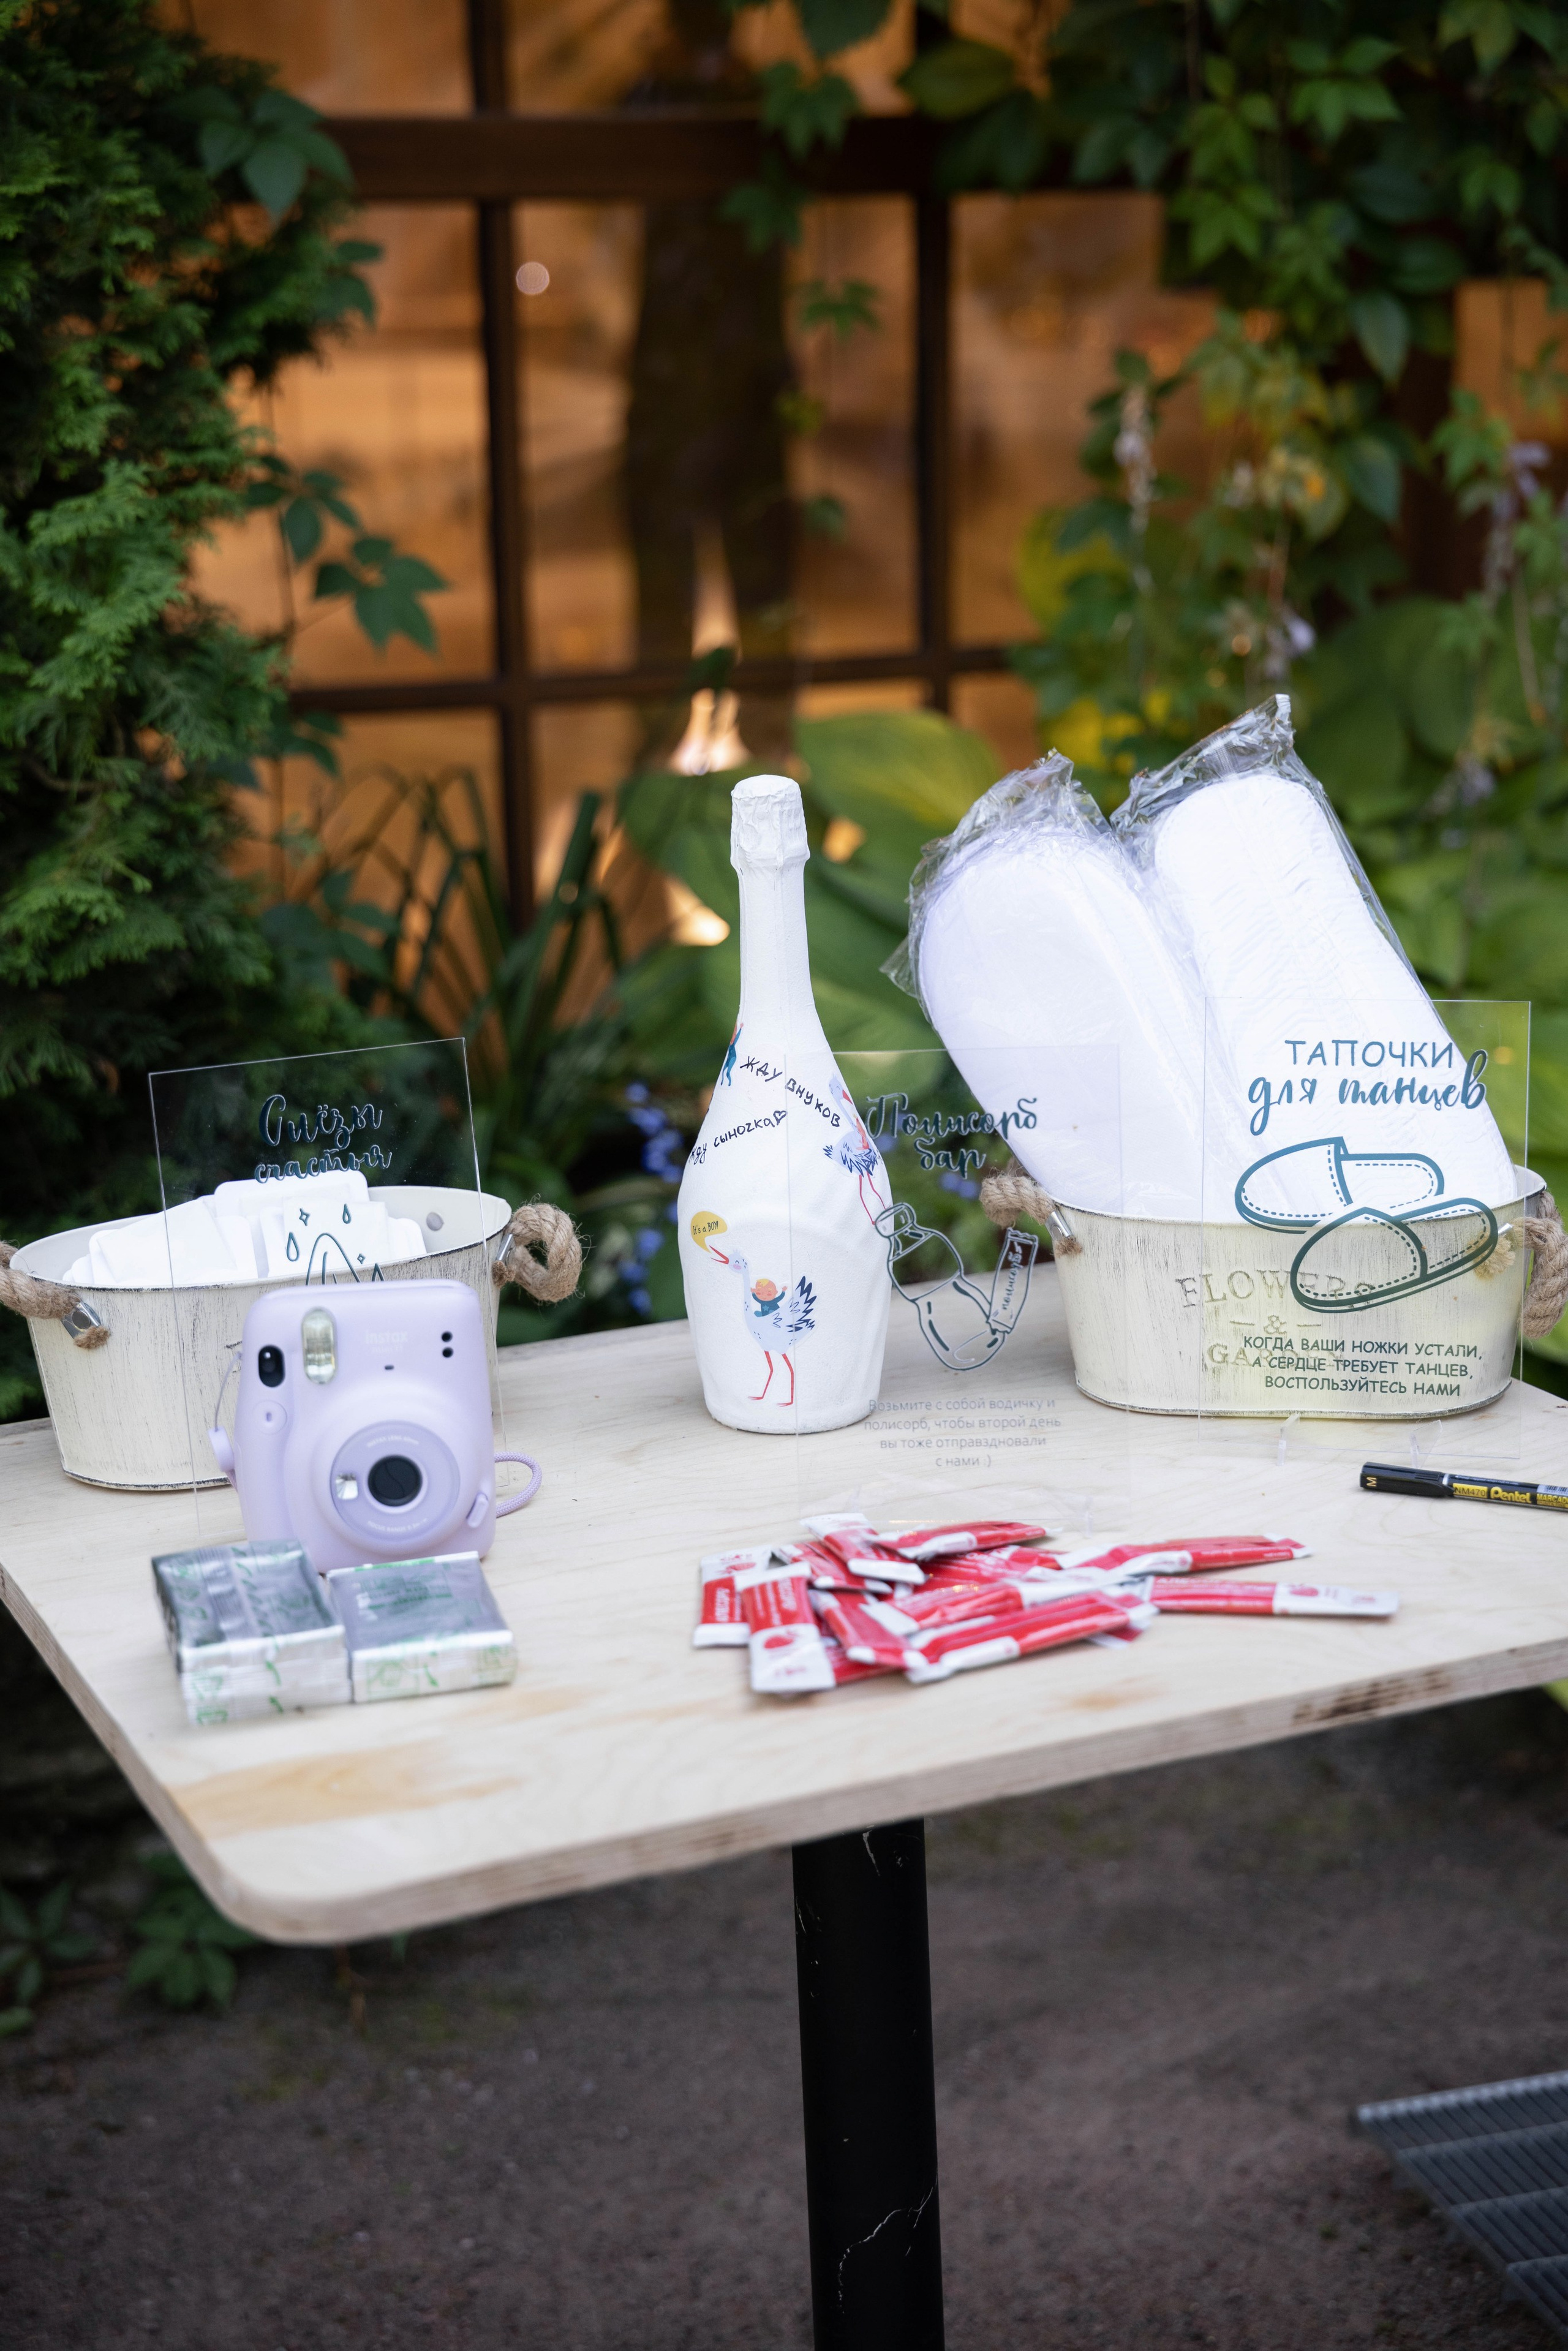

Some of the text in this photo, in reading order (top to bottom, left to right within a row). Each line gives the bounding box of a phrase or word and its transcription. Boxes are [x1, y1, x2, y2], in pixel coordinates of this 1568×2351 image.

[1284, 1040, 1453, 1068] ТАПОЧКИ
[1248, 1049, 1488, 1136] для танцев
[258, 1093, 383, 1150] Слёзы
[865, 1092, 1038, 1140] Полисорб
[254, 1144, 393, 1184] счастья
[913, 1136, 986, 1180] бар
[1243, 1335, 1483, 1360] КОГДА ВАШИ НОЖКИ УСТАЛИ,
[1252, 1356, 1474, 1380] А СЕРДЦЕ ТРЕБУЕТ ТАНЦЕВ,
[1265, 1375, 1461, 1397] ВОСПОЛЬЗУЙТЕСЬ НАМИ
[869, 1397, 1055, 1411] Возьмите с собой водичку и
[864, 1414, 1061, 1433] полисорб, чтобы второй день
[880, 1440, 897, 1449] вы
[900, 1438, 933, 1449] тоже
[935, 1457, 943, 1467] с
[946, 1457, 980, 1466] нами
[1490, 1485, 1532, 1504] Pentel
[1536, 1493, 1568, 1504] MARCAD
